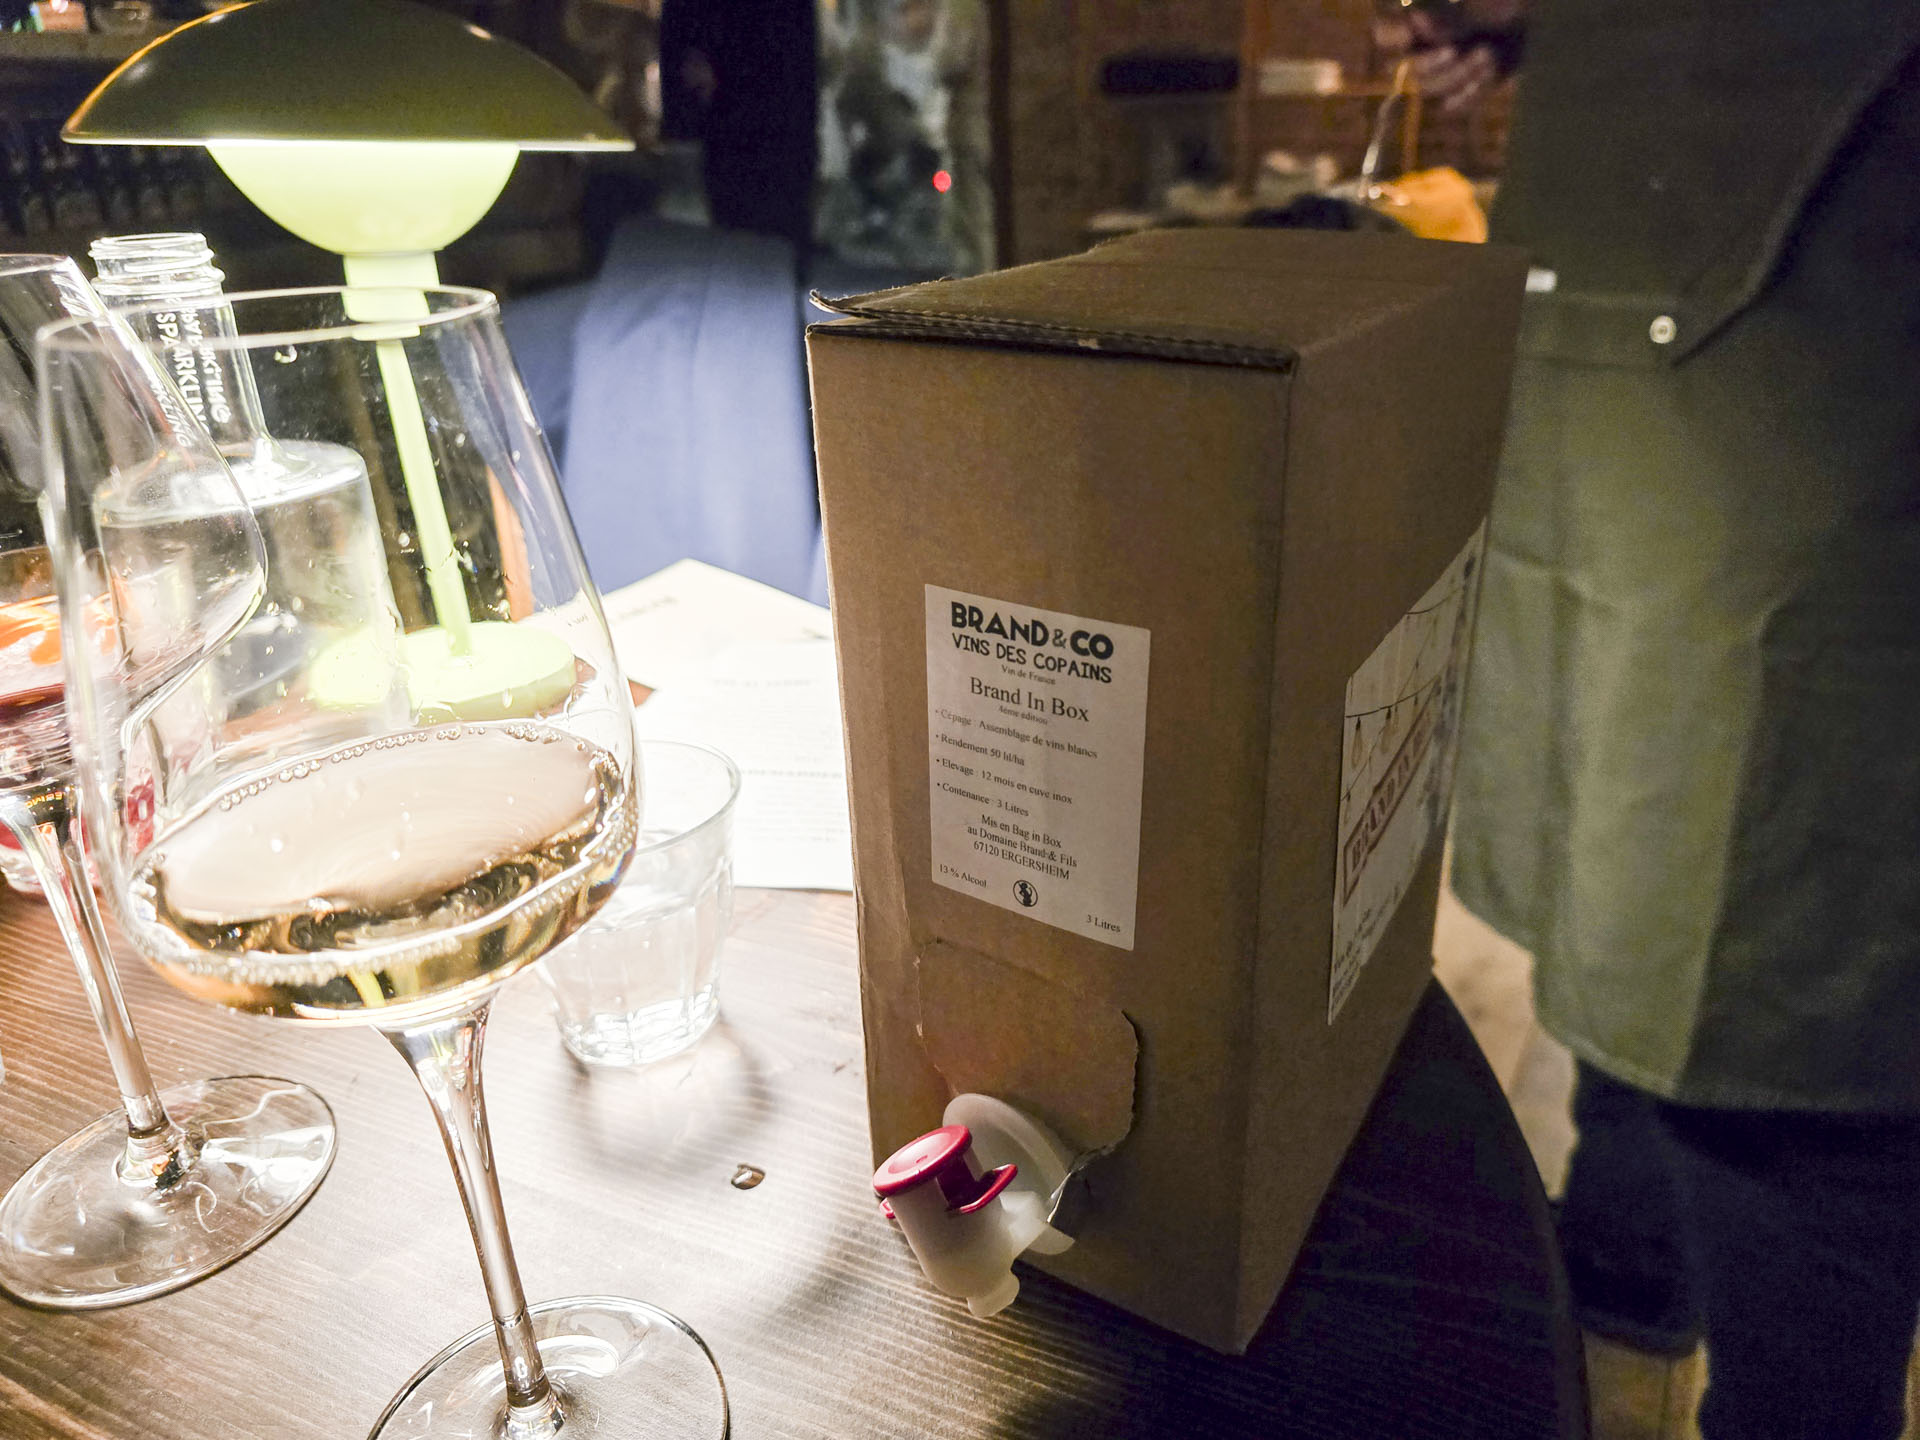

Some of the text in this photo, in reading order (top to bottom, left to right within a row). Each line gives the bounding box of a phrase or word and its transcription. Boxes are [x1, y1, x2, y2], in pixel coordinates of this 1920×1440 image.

[952, 632, 1112, 684] VINS DES COPAINS
[1001, 664, 1016, 676] Vin
[1017, 669, 1027, 678] de
[970, 676, 1089, 722] Brand In Box
[941, 733, 988, 755] Rendement
[990, 748, 1001, 759] 50
[979, 720, 1031, 743] Assemblage
[1032, 734, 1044, 746] de
[1045, 739, 1065, 751] vins
[1067, 742, 1098, 759] blancs
[942, 758, 974, 776] Elevage
[982, 770, 992, 781] 12
[994, 776, 1015, 788] mois
[1016, 783, 1027, 792] en
[1028, 786, 1050, 799] cuve
[1052, 792, 1072, 804] inox
[942, 782, 990, 804] Contenance
[997, 799, 1003, 808] 3
[1005, 801, 1029, 817] Litres
[967, 826, 1077, 868] au Domaine Brand & Fils
[981, 814, 1062, 849] Mis en Bag in Box
[940, 863, 987, 888] 13 % Alcool
[973, 840, 1070, 880] 67120 ERGERSHEIM
[1086, 914, 1121, 933] 3 Litres
